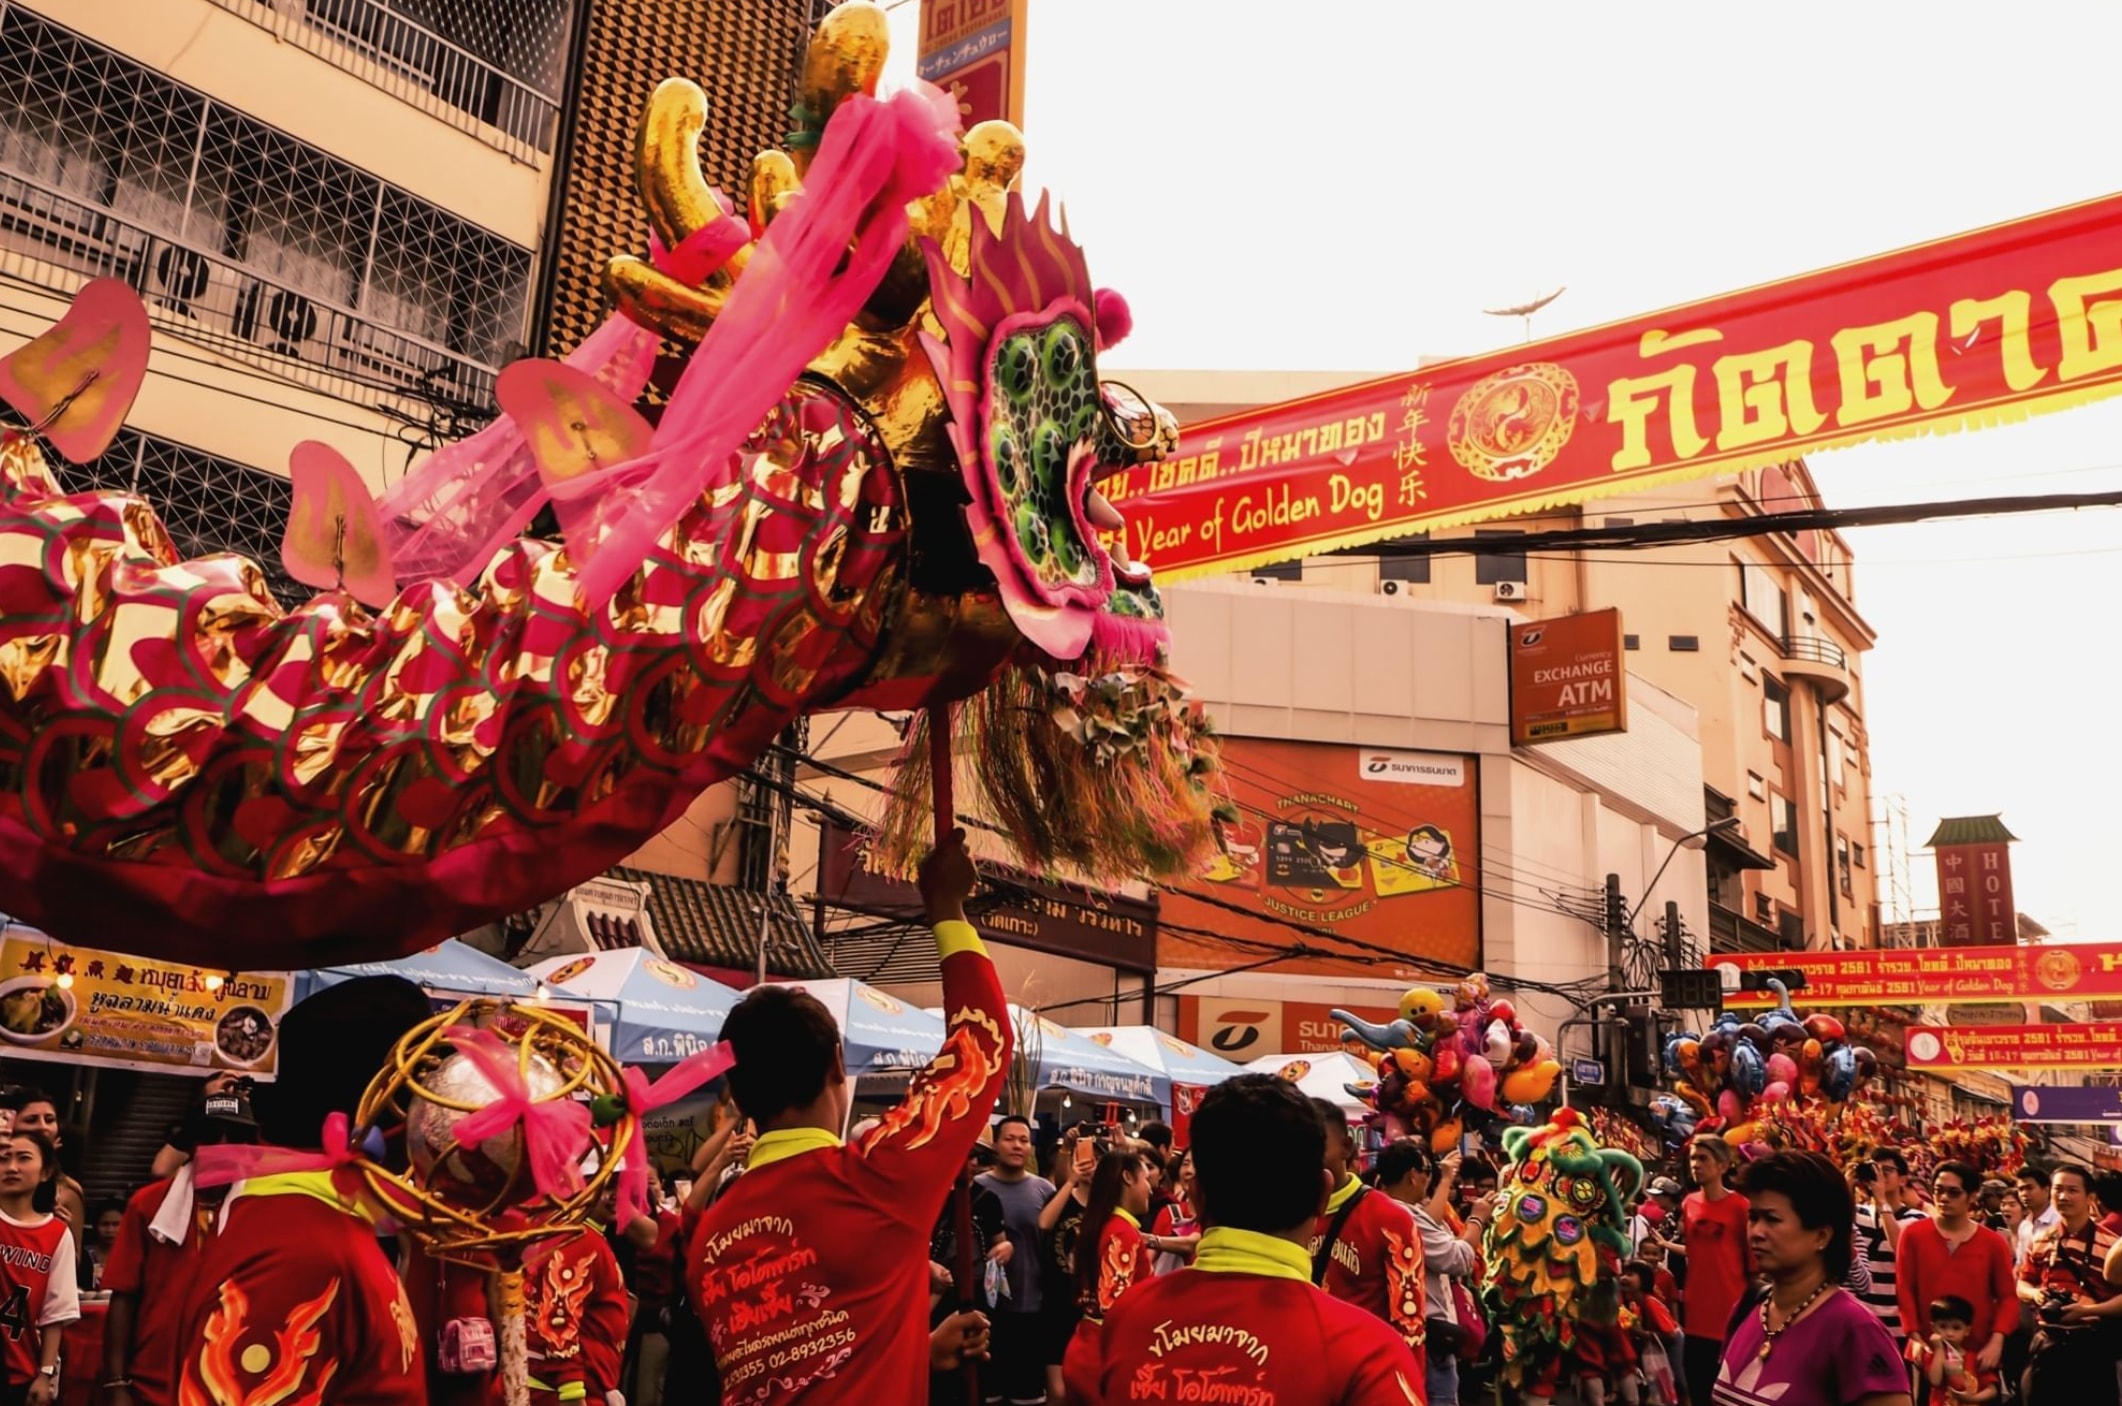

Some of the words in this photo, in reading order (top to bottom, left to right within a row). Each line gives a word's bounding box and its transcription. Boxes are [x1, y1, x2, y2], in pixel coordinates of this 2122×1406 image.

[1393, 382, 1433, 507] 新年快乐
[1136, 516, 1191, 562] Year
[1200, 497, 1224, 553] of
[1232, 483, 1321, 534] Golden
[1329, 474, 1384, 521] Dog
[1534, 660, 1613, 683] EXCHANGE
[1558, 678, 1612, 708] ATM
[1276, 793, 1360, 814] THANACHART
[1264, 897, 1317, 922] JUSTICE
[1321, 901, 1370, 922] LEAGUE
[703, 1215, 794, 1265] ขโมยมาจาก
[1, 1285, 31, 1342] 4
[768, 1328, 857, 1369] 02-8932356
[1148, 1319, 1269, 1366] ขโมยมาจาก
